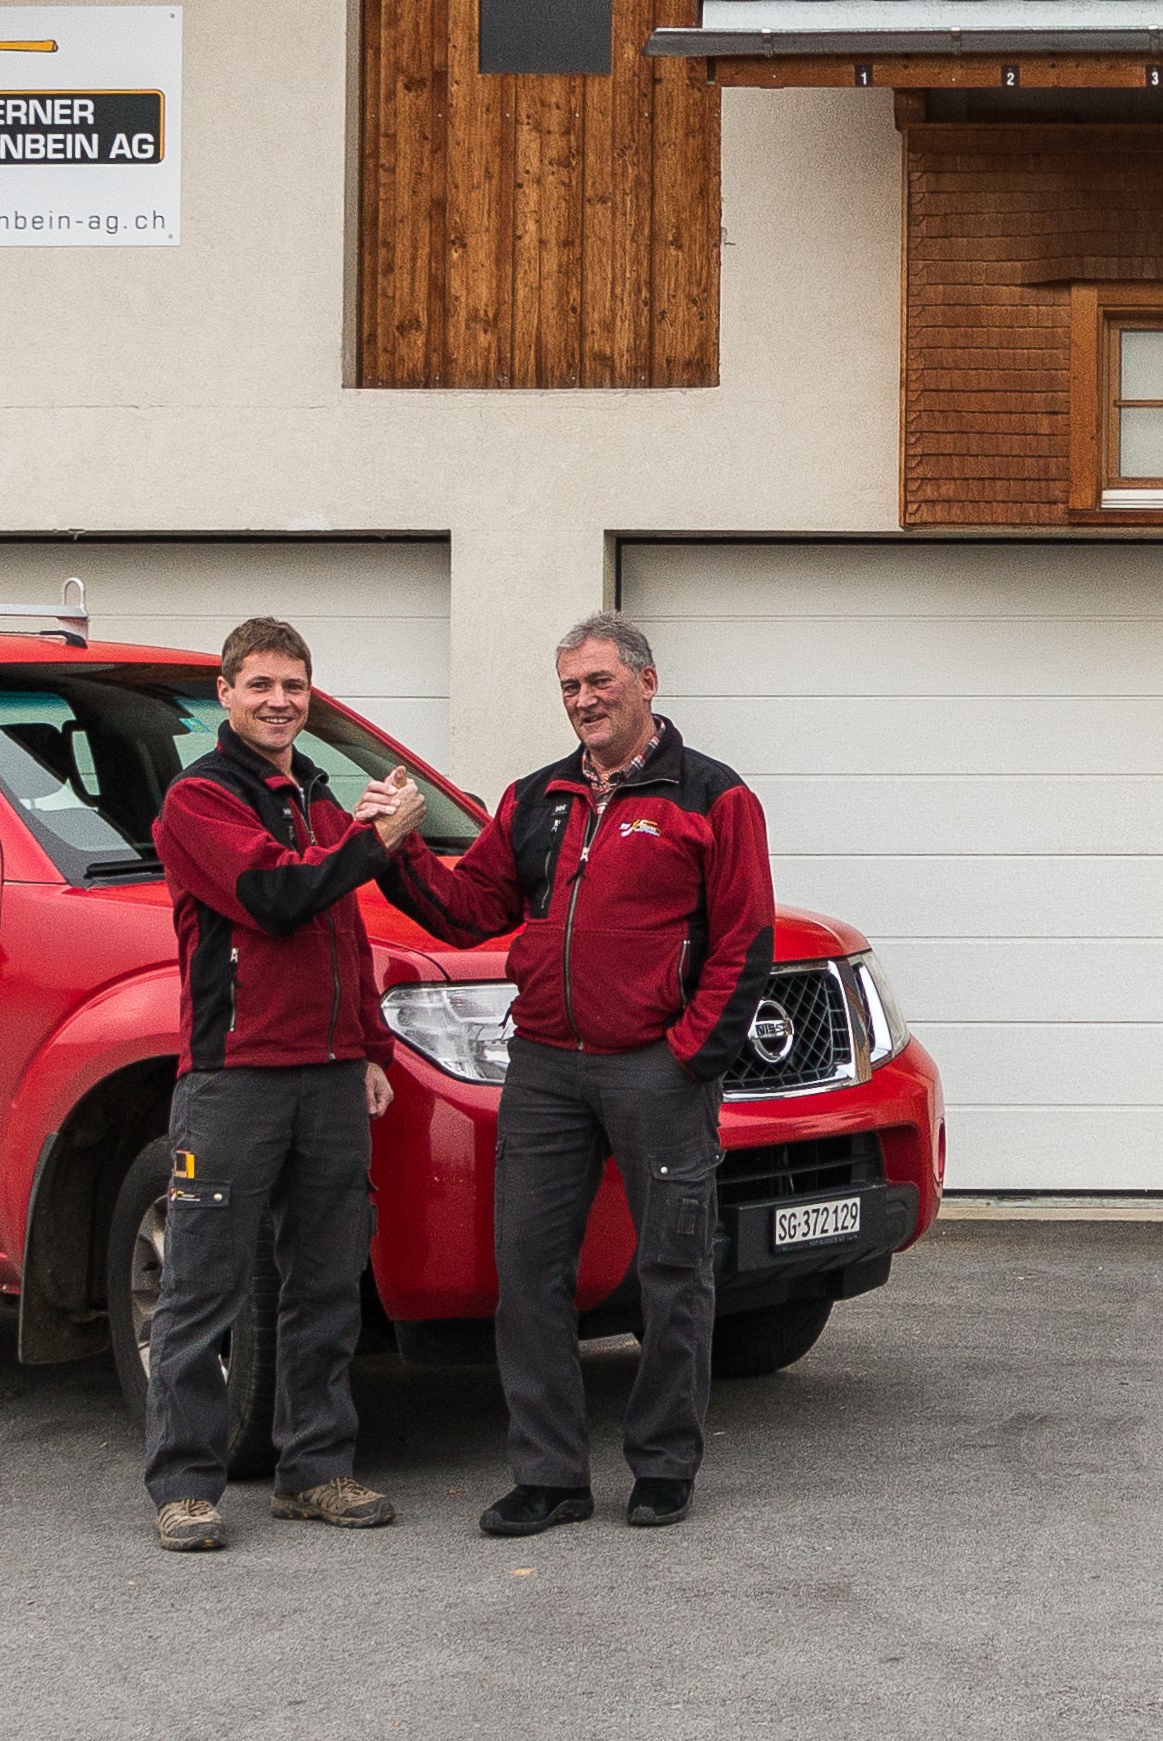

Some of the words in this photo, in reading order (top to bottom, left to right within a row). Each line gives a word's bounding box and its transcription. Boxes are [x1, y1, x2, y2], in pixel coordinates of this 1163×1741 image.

[860, 71, 867, 86] 1
[1006, 71, 1015, 87] 2
[1151, 71, 1159, 86] 3
[108, 133, 155, 160] AG
